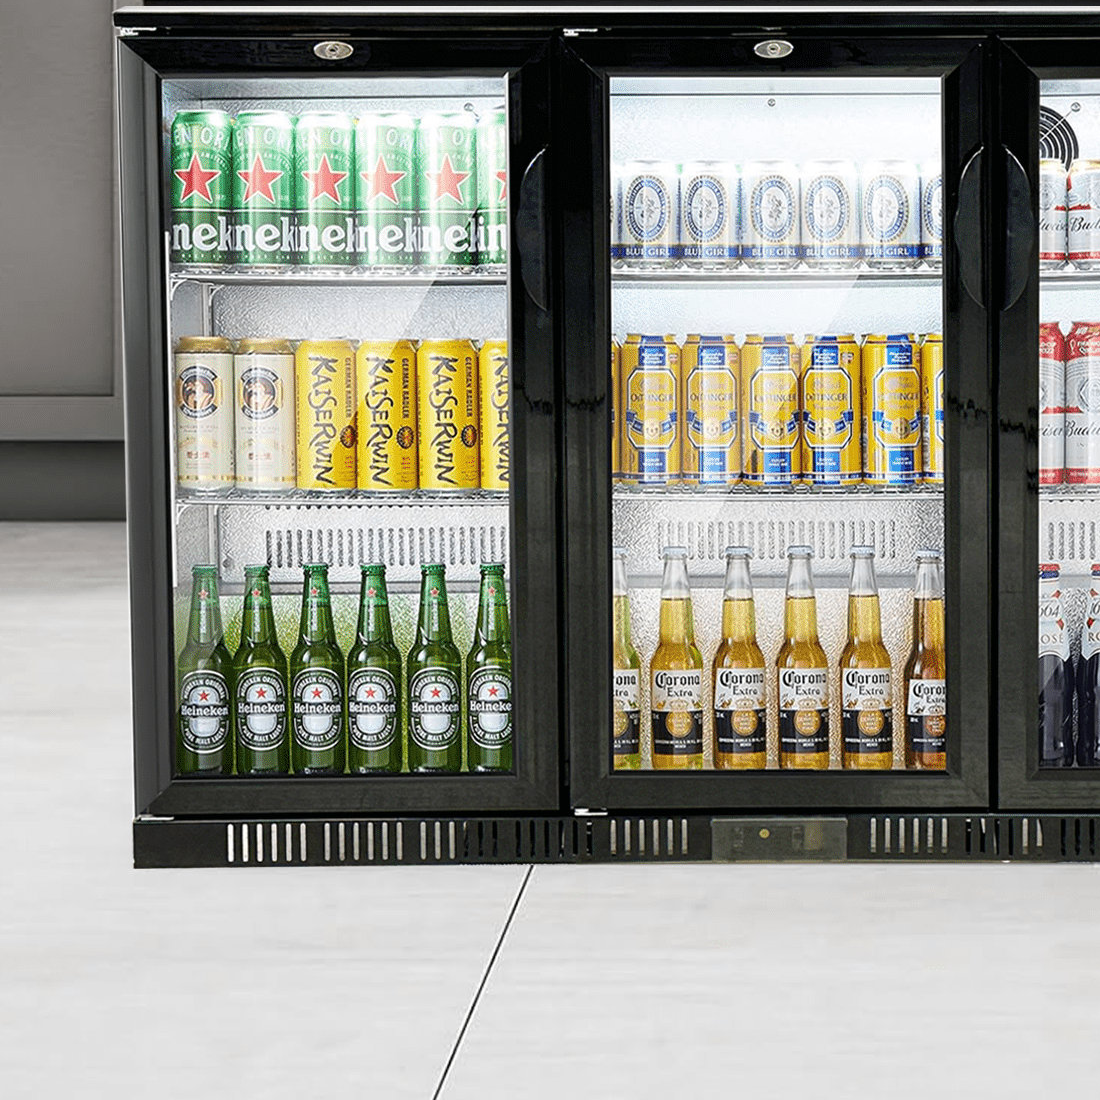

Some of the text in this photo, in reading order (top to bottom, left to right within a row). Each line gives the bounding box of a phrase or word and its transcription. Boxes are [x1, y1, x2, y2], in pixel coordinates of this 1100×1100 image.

[308, 356, 338, 485] KAISERWIN
[365, 356, 395, 486] KAISERWIN
[429, 356, 459, 486] KAISERWIN
[655, 672, 700, 691] Corona
[667, 688, 693, 698] Extra
[733, 686, 758, 696] Extra
[795, 685, 820, 695] Extra
[859, 685, 884, 695] Extra
[181, 705, 229, 716] Heineken
[238, 702, 286, 713] Heineken
[294, 702, 341, 713] Heineken
[349, 702, 396, 713] Heineken
[412, 702, 459, 713] Heineken
